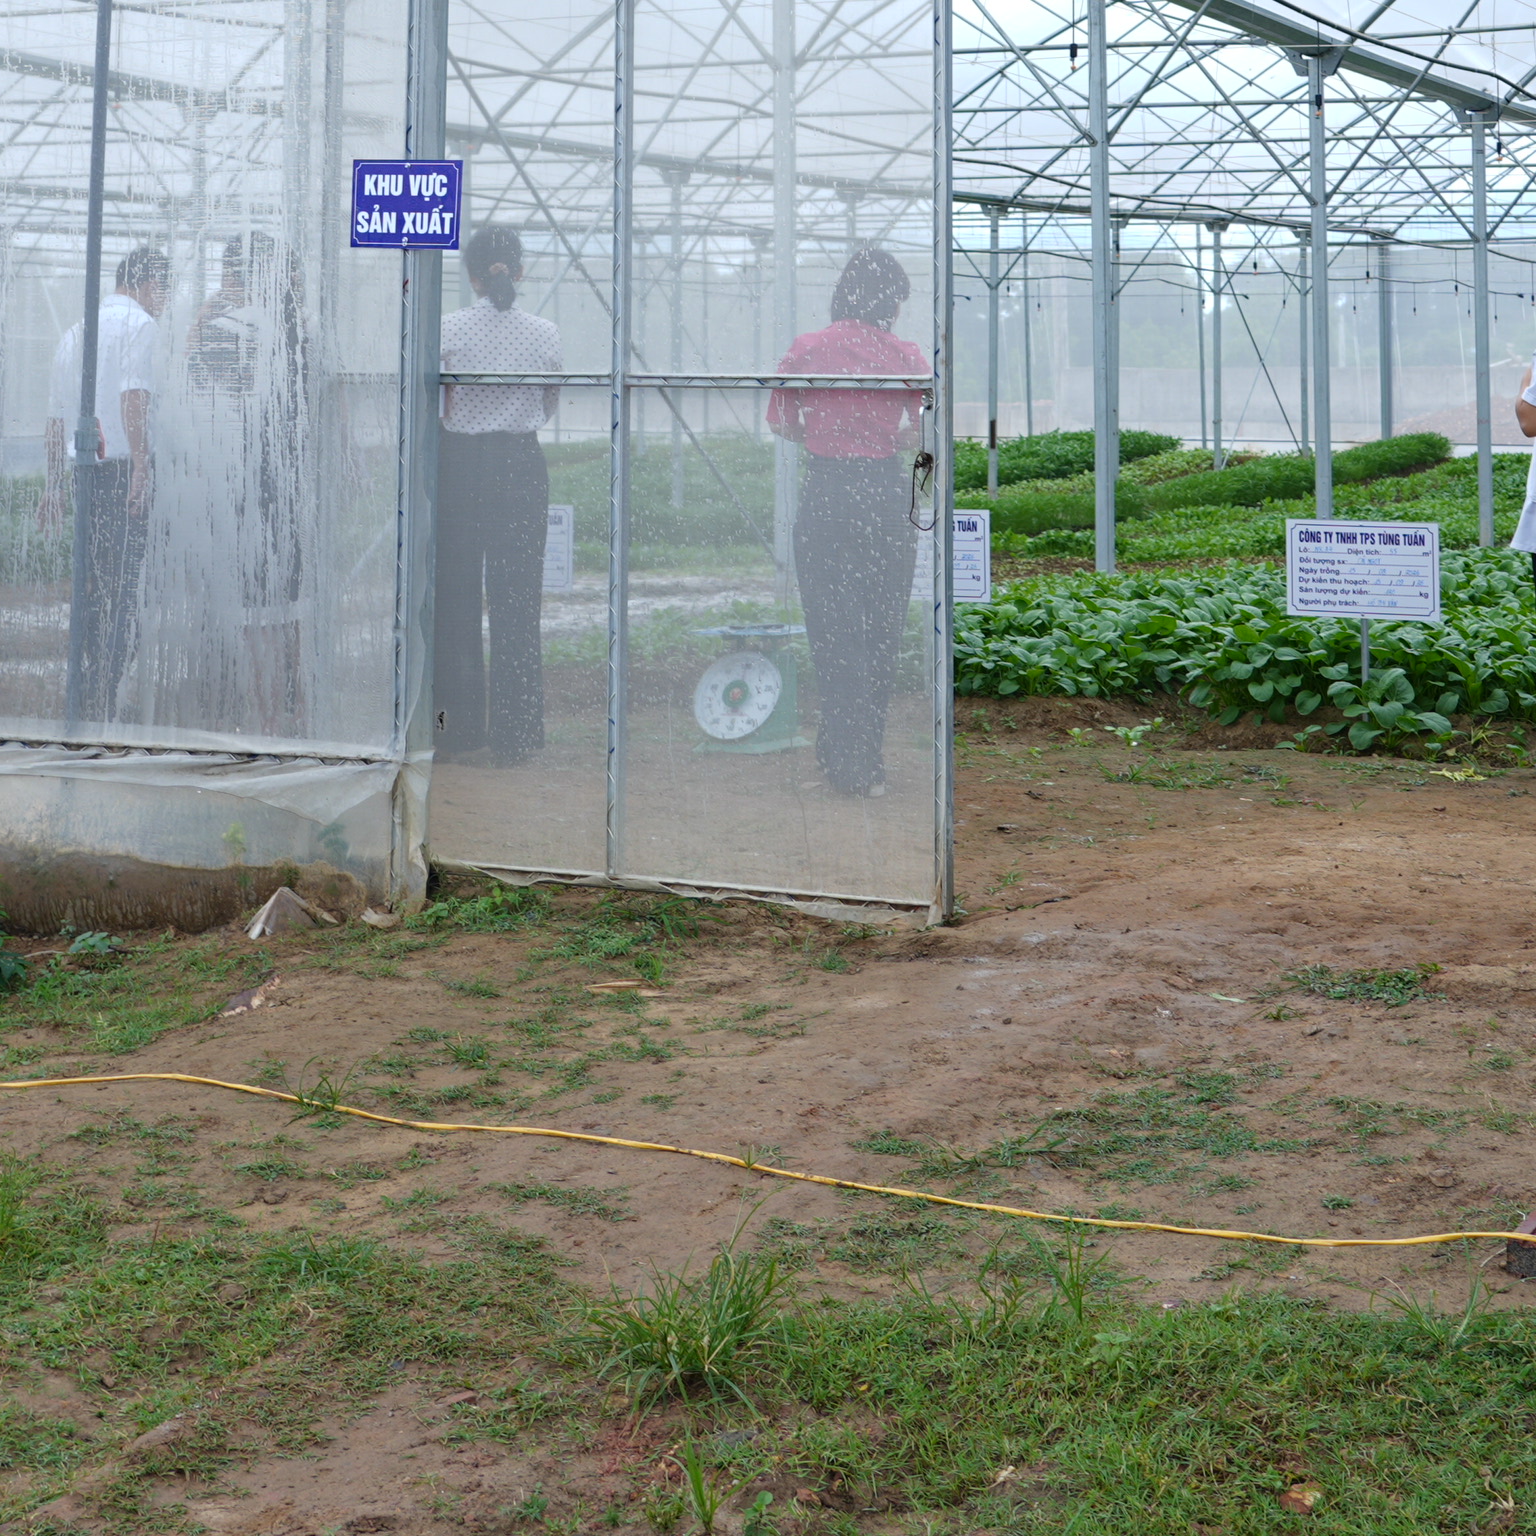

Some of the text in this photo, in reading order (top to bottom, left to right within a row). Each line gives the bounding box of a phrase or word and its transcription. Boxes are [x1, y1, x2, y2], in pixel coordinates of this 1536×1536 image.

[364, 172, 448, 201] KHU VỰC
[356, 204, 454, 234] SẢN XUẤT
[957, 517, 977, 532] TUẤN
[1299, 528, 1425, 546] CÔNG TY TNHH TPS TÙNG TUẤN
[1299, 567, 1318, 575] Ngày
[1419, 591, 1429, 599] kg
